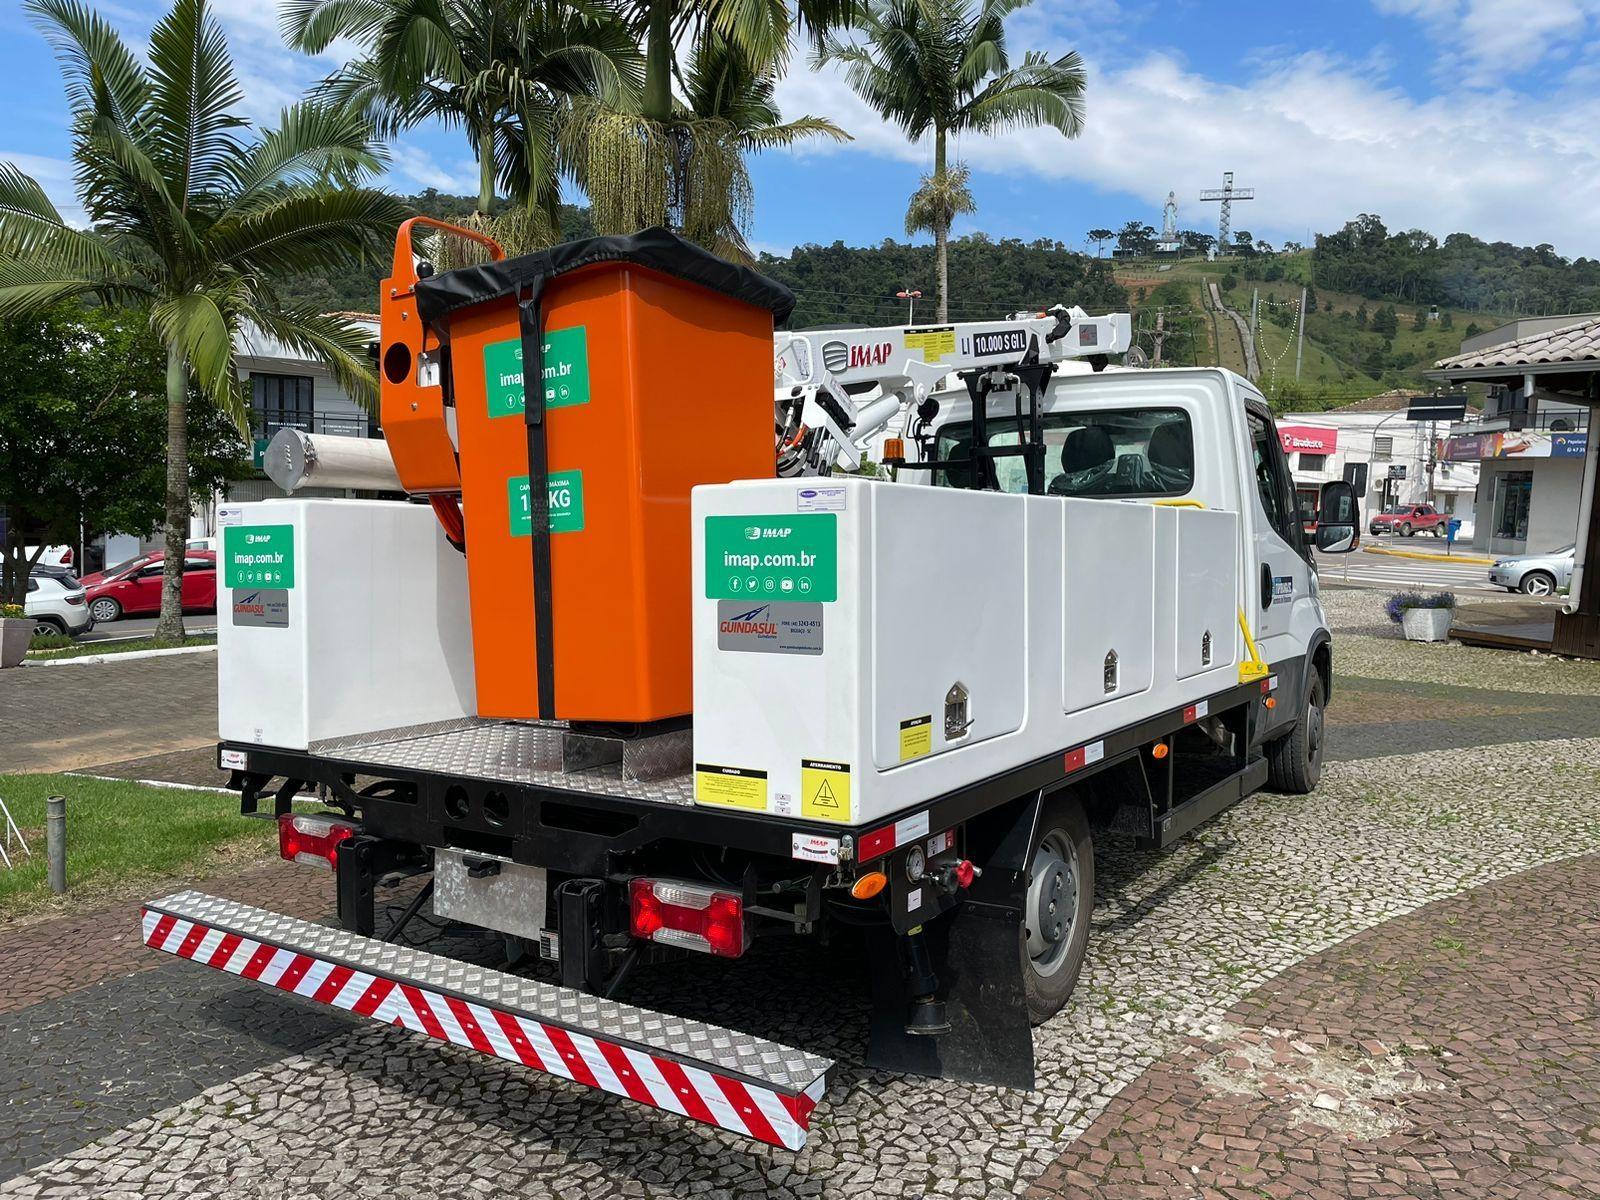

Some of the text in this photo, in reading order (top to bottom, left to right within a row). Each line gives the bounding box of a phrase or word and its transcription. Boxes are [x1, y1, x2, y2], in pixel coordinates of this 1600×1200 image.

[962, 337, 970, 355] LI
[976, 335, 1003, 353] 10.000
[1004, 334, 1010, 351] S
[254, 535, 271, 543] IMAP
[763, 528, 792, 537] IMAP
[234, 552, 284, 566] imap.com.br
[724, 550, 816, 570] imap.com.br
[720, 621, 777, 635] GUINDASUL
